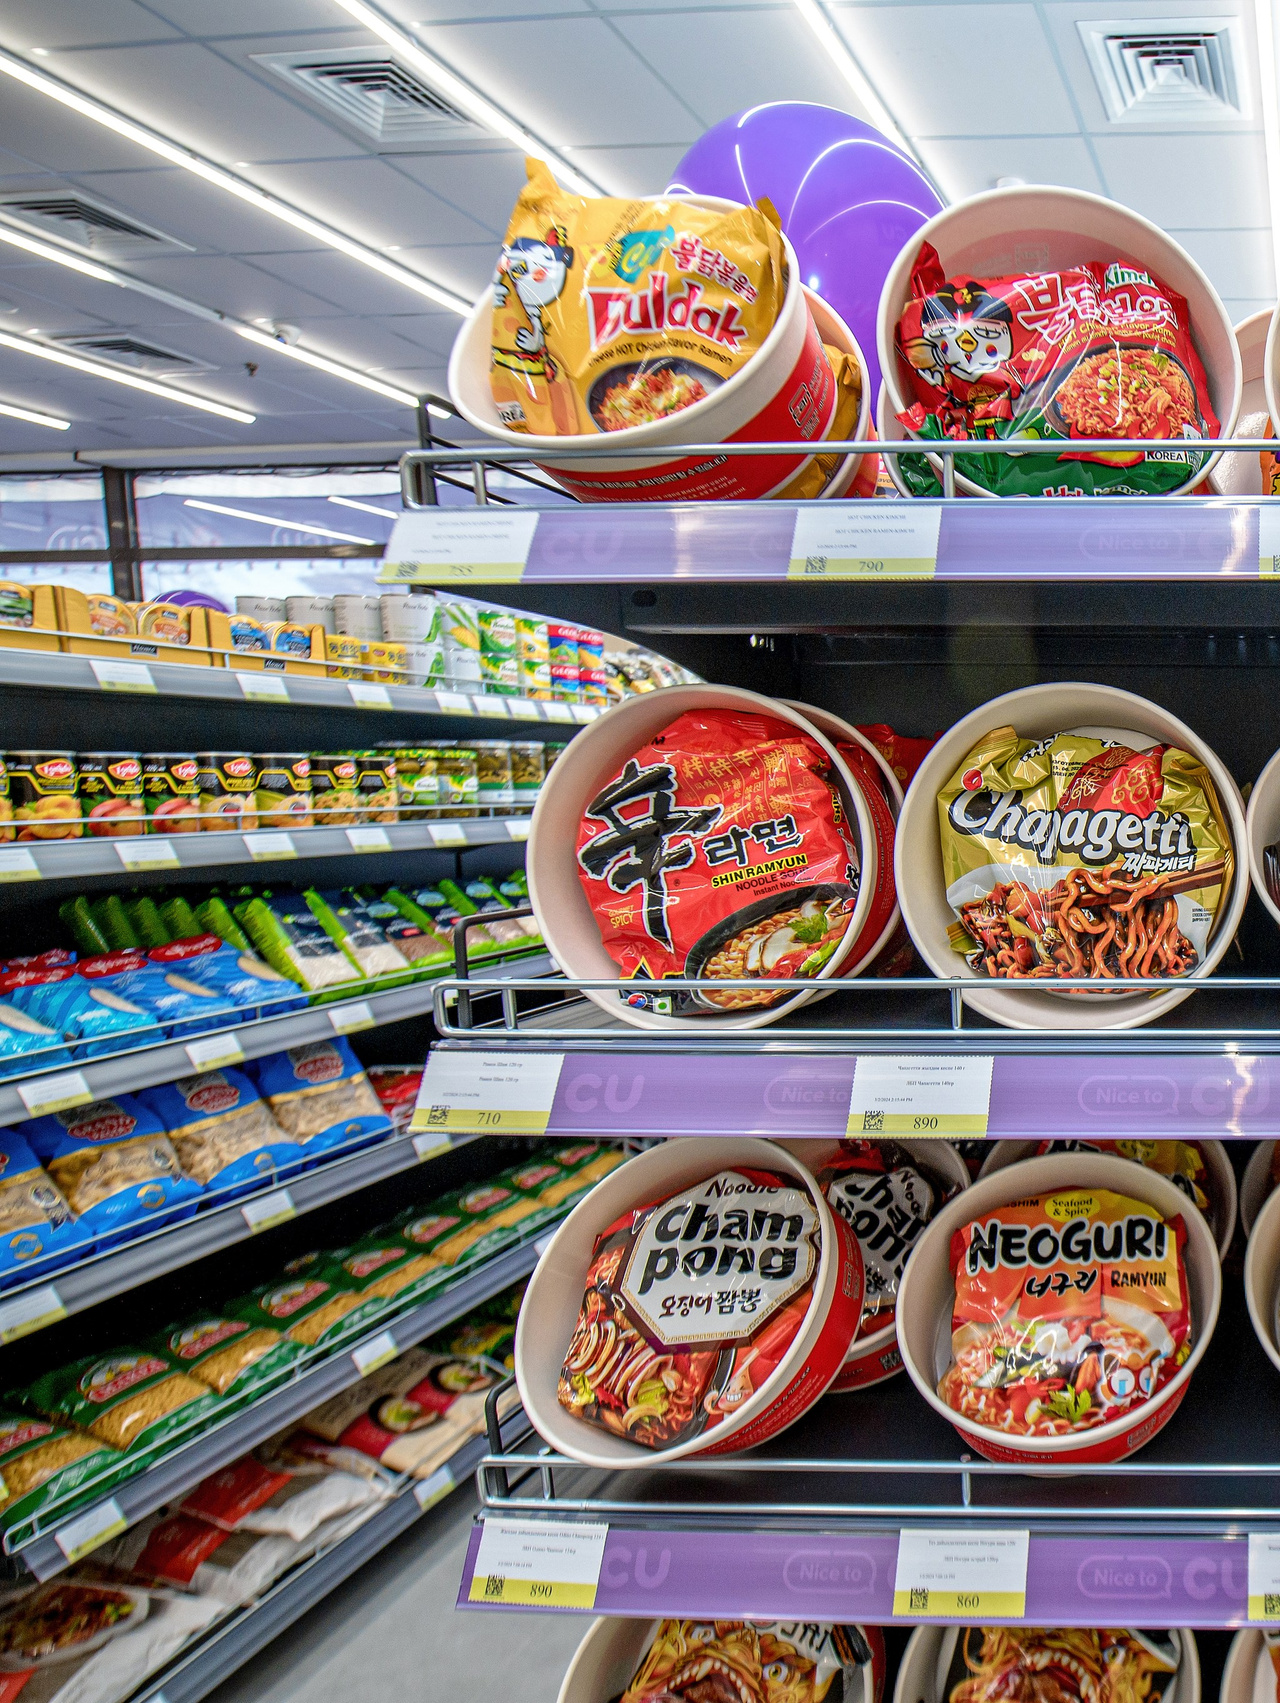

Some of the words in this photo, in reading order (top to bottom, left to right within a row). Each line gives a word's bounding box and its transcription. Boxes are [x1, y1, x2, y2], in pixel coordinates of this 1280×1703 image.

[859, 561, 884, 572] 790
[702, 814, 803, 868] 라면
[711, 867, 745, 888] SHIN
[745, 853, 809, 880] RAMYUN
[1122, 851, 1197, 878] 짜파게티
[735, 873, 778, 892] NOODLE
[753, 883, 779, 897] Instant
[610, 914, 633, 929] SPICY
[565, 1074, 645, 1113] CU
[781, 1086, 825, 1102] Nice
[1096, 1087, 1140, 1104] Nice
[1142, 1088, 1164, 1104] to
[477, 1112, 501, 1125] 710
[913, 1117, 938, 1130] 890
[1052, 1197, 1093, 1209] Seafood
[1052, 1207, 1061, 1216] &
[1064, 1206, 1091, 1218] Spicy
[966, 1217, 1169, 1277] NEOGURI
[638, 1243, 798, 1295] pong
[1025, 1268, 1099, 1298] 너구리
[1110, 1270, 1167, 1288] RAMYUN
[602, 1547, 672, 1589] CU
[1094, 1568, 1136, 1586] Nice
[1139, 1569, 1157, 1586] to
[530, 1583, 553, 1598] 890
[957, 1594, 980, 1609] 860
